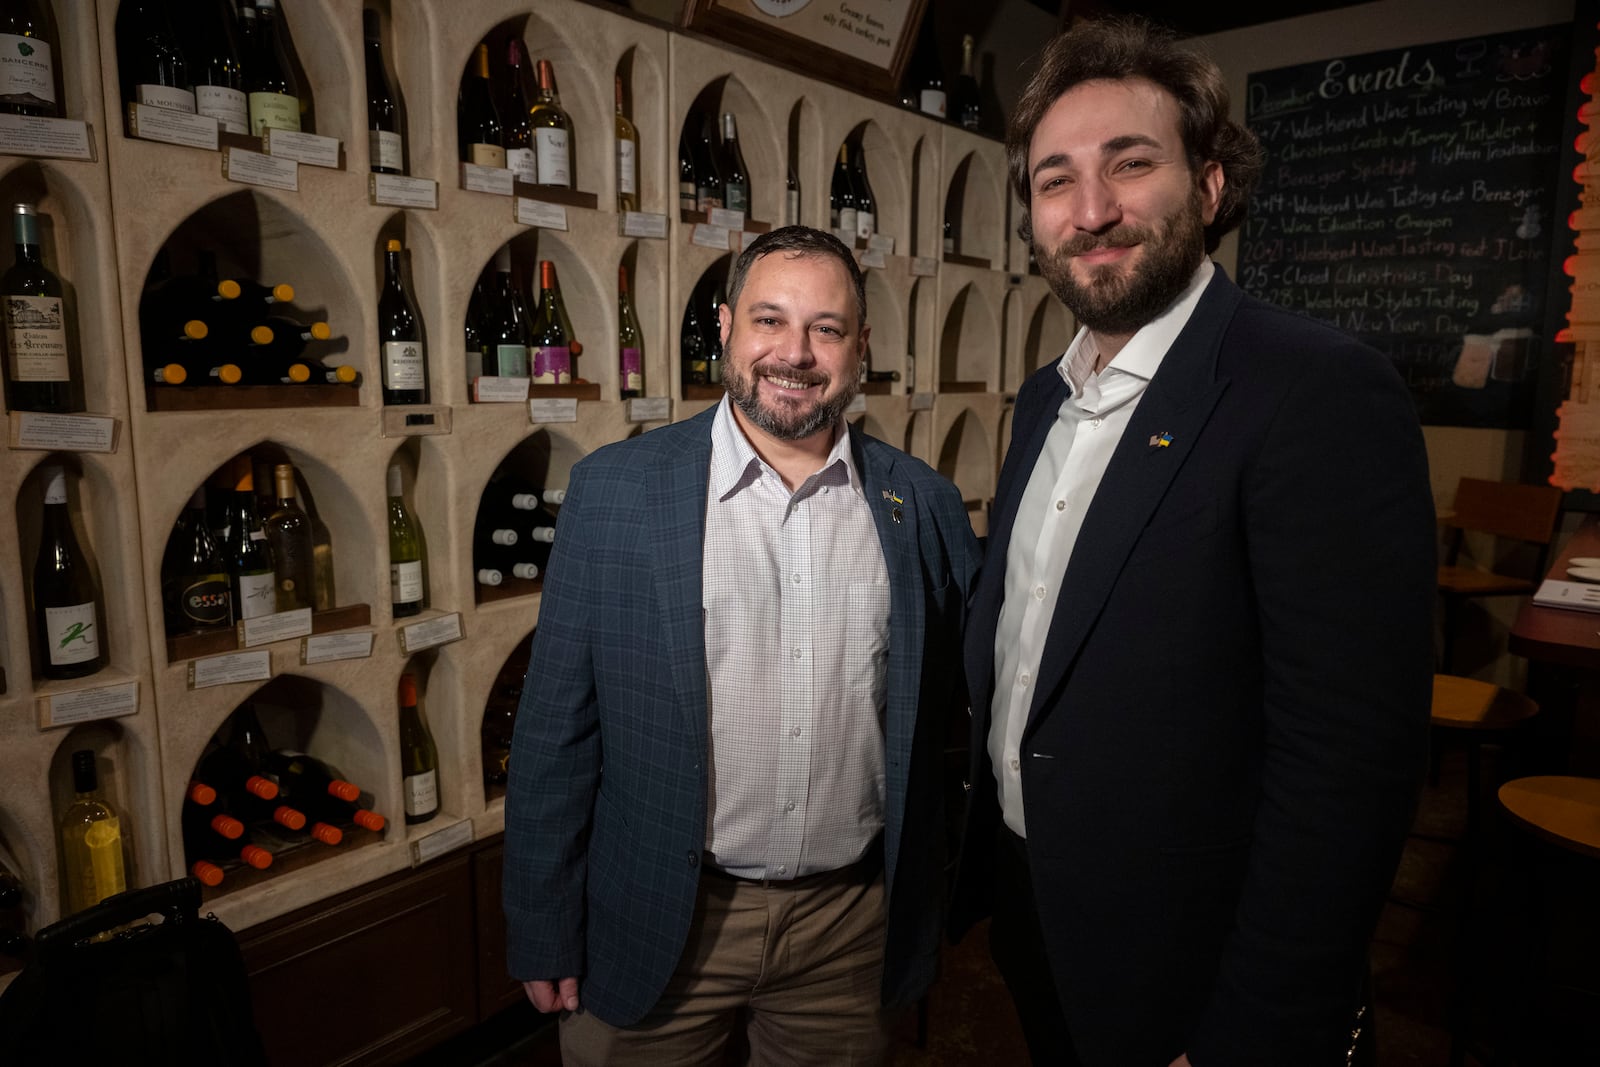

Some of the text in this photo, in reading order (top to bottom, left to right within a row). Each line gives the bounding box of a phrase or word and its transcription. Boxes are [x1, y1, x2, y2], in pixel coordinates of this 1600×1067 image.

[1, 57, 49, 71] SANCERRE
[1319, 51, 1435, 99] Events
[1250, 82, 1316, 117] December
[1290, 105, 1369, 139] Weekend
[1372, 101, 1409, 123] Wine
[1408, 93, 1468, 119] Tasting
[1280, 140, 1350, 162] Christmas
[1408, 129, 1458, 149] Tommy
[1293, 192, 1350, 216] Weekend
[1354, 190, 1387, 211] Wine
[1387, 184, 1438, 210] Tasting
[1472, 178, 1546, 209] Benziger
[1280, 216, 1313, 235] Wine
[1317, 213, 1386, 234] Education
[1395, 212, 1453, 237] Oregon
[1293, 238, 1357, 262] Weekend
[1360, 238, 1396, 258] Wine
[1395, 234, 1456, 258] Tasting
[1243, 264, 1270, 289] 25
[1282, 265, 1330, 286] Closed
[1335, 263, 1428, 286] Christmas
[1435, 263, 1474, 291] Day
[1304, 287, 1368, 310] Weekend
[1373, 288, 1421, 313] Styles
[1420, 287, 1480, 318] Tasting
[1350, 311, 1384, 333] New
